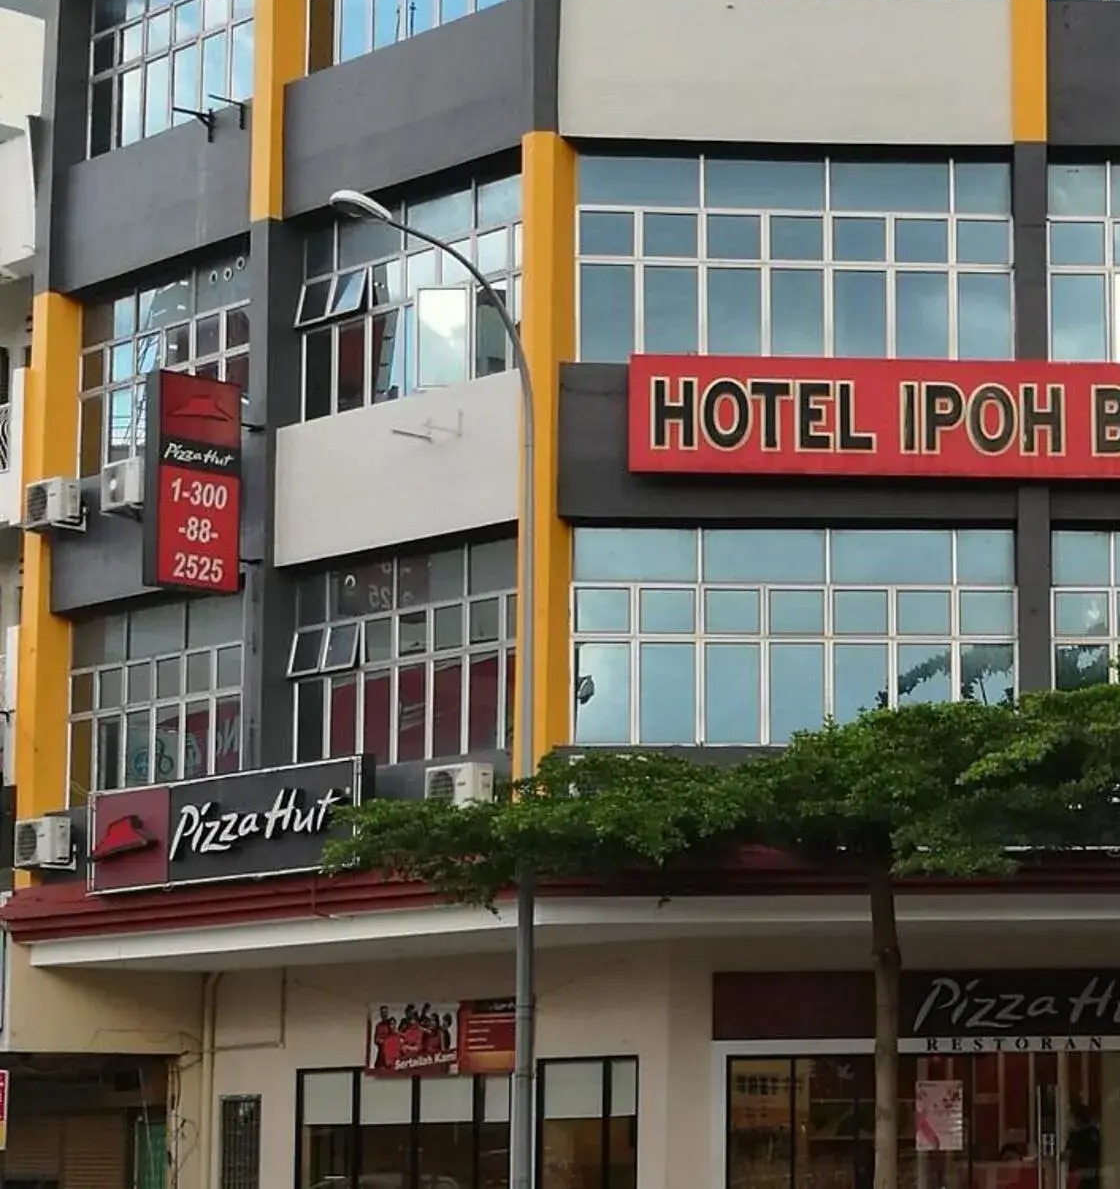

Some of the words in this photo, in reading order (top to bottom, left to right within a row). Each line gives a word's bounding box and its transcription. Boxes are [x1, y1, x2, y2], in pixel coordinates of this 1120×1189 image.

[649, 375, 877, 453] HOTEL
[900, 380, 1066, 458] IPOH
[164, 441, 203, 462] Pizza
[203, 448, 235, 467] Hut
[171, 477, 228, 510] 1-300
[178, 516, 219, 544] -88-
[173, 551, 224, 583] 2525
[169, 801, 260, 861] Pizza
[263, 787, 342, 840] Hut
[912, 976, 1060, 1033] Pizza
[926, 1035, 1103, 1053] RESTORAN
